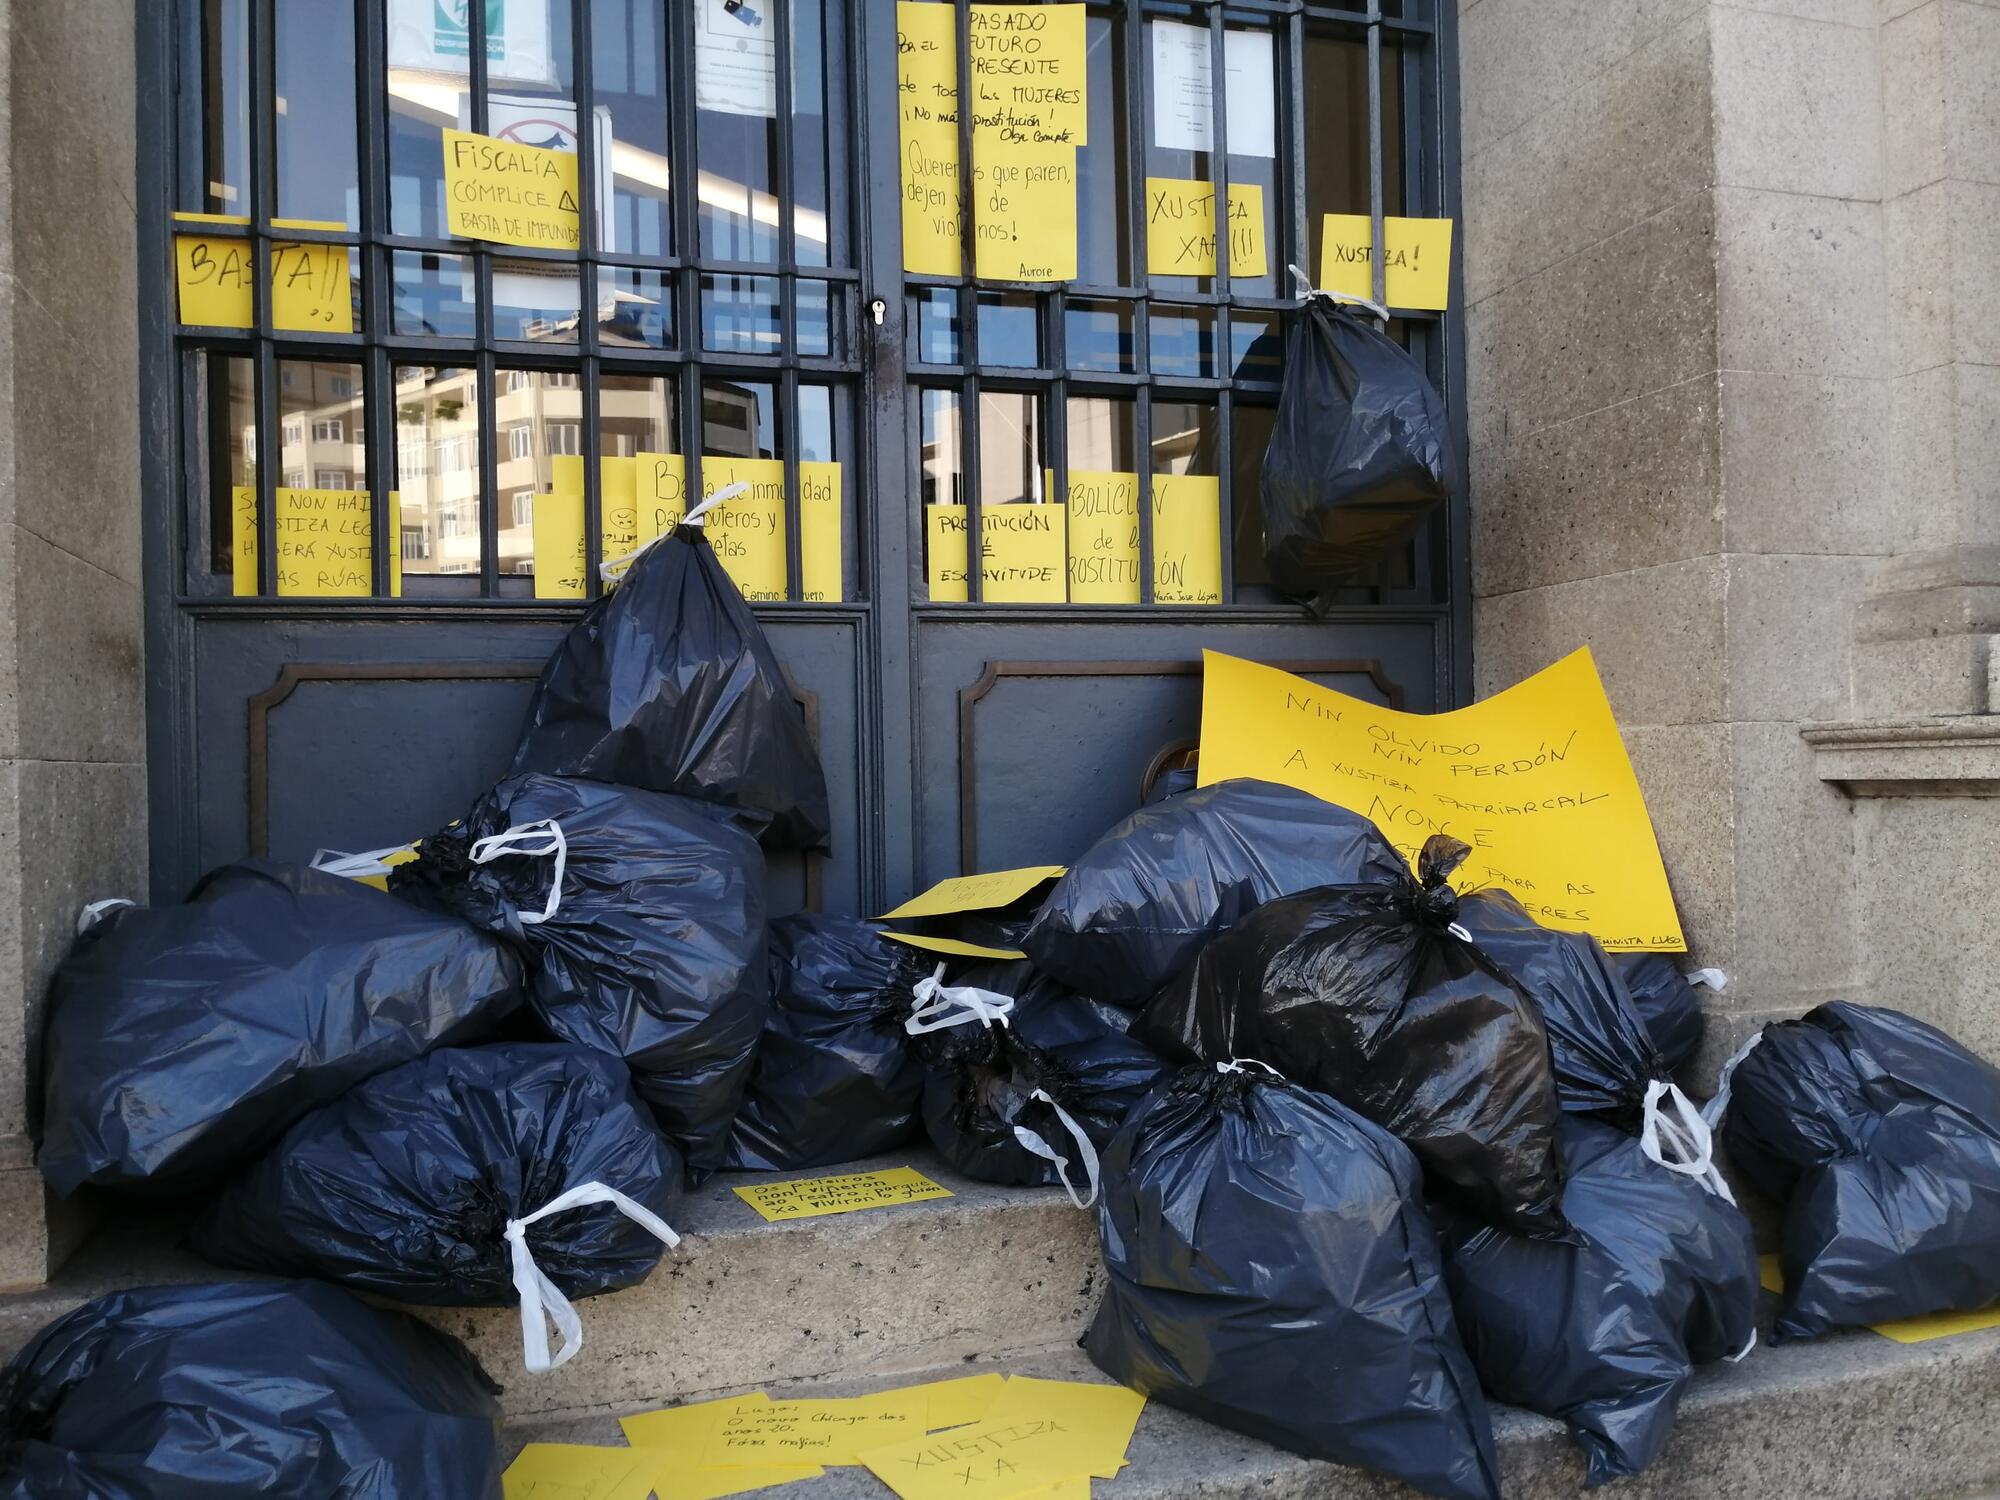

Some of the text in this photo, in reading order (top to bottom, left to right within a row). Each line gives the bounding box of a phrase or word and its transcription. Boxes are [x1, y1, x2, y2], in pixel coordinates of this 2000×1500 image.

[970, 12, 1047, 31] PASADO
[921, 40, 939, 51] EL
[970, 35, 1042, 54] FUTURO
[898, 74, 1081, 104] de tod las MUJERES
[937, 110, 959, 123] má
[908, 139, 1071, 190] Queres que paren,
[907, 173, 946, 213] dejen
[989, 189, 1009, 213] de
[1151, 190, 1248, 224] XUSTZA
[460, 212, 500, 234] BASTA
[504, 217, 522, 238] DE
[1019, 262, 1053, 278] Aurore
[752, 474, 832, 502] inmudad
[289, 494, 327, 510] NON
[1067, 483, 1168, 518] BOLICIN
[246, 516, 329, 533] XSTIZA
[767, 512, 776, 535] y
[938, 509, 1050, 534] PROTITUCIÓN
[1093, 528, 1114, 550] de
[276, 567, 368, 588] AS RÚAS
[940, 567, 1056, 581] ESCAVITUDE
[1069, 552, 1187, 588] ROSTITUÓN
[741, 583, 780, 602] Camino
[1286, 692, 1481, 756] NIN OLVIDO
[1373, 730, 1577, 777] NIN PERDÓN
[1283, 749, 1307, 769] A
[1432, 792, 1609, 816] PATRIARCAL
[1482, 865, 1596, 895] PARA AS
[1594, 934, 1681, 946] EMINISTA LUGO
[754, 1186, 779, 1194] Os
[757, 1190, 794, 1201] non
[810, 1412, 869, 1426] Chicago
[878, 1411, 907, 1422] dos
[897, 1420, 1071, 1471] XUSTIZA
